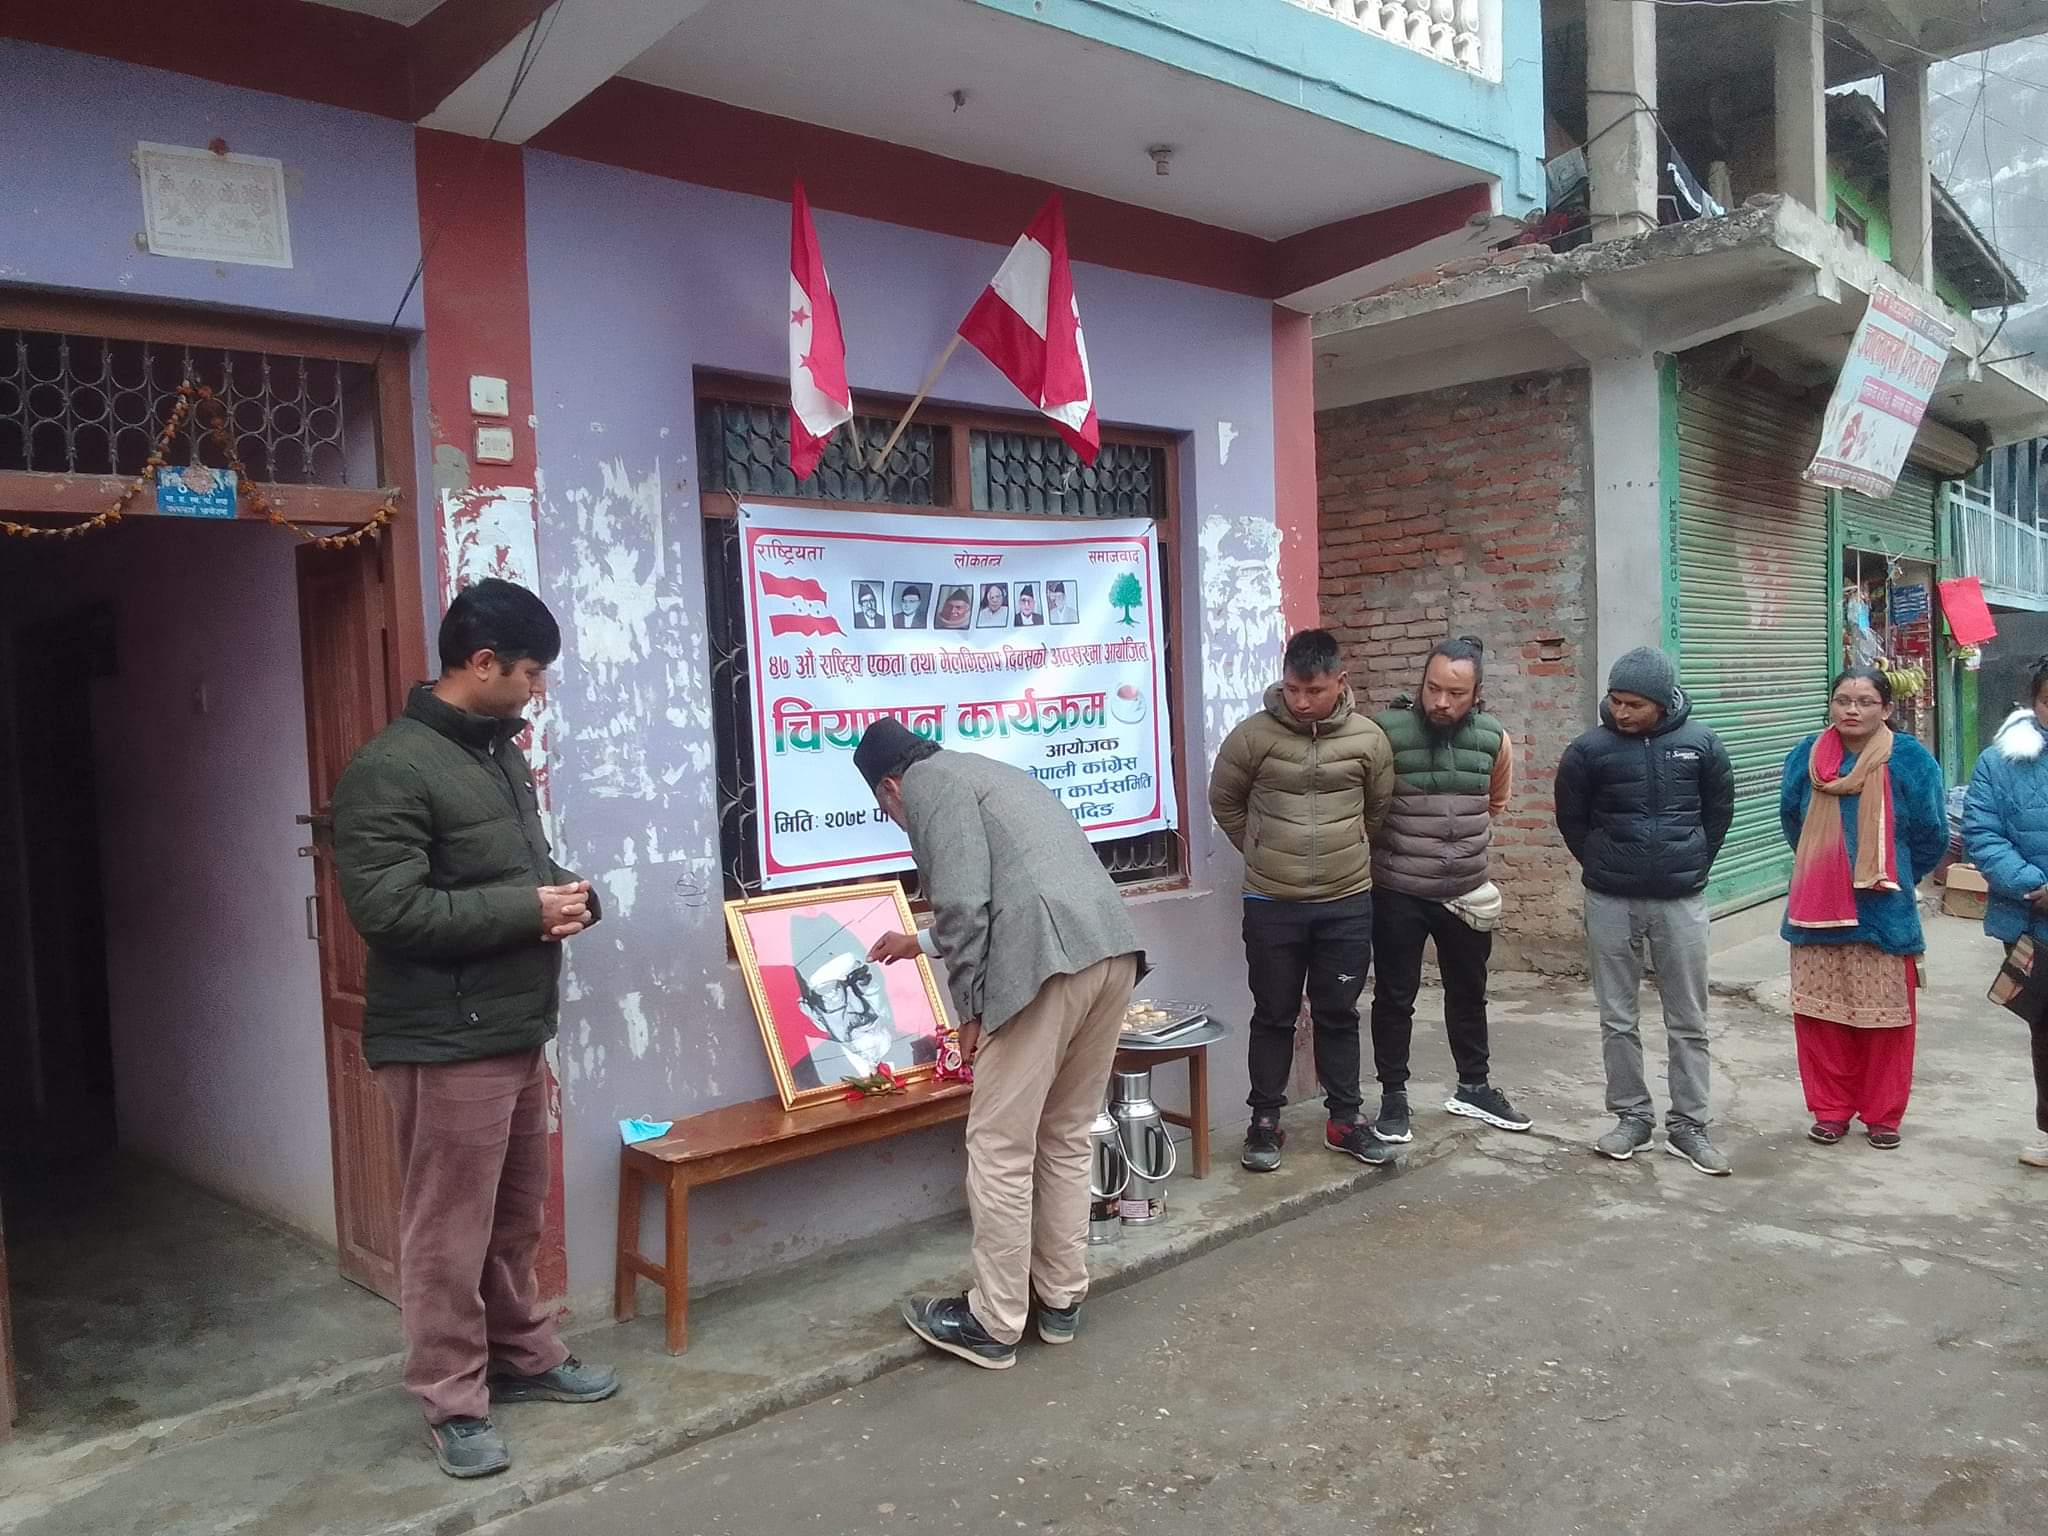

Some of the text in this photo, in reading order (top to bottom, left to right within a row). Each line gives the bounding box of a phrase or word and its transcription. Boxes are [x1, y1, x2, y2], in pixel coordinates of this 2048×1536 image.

[755, 538, 826, 565] राष्ट्रियता
[1088, 549, 1139, 565] समाजवाद
[1669, 496, 1679, 640] OPC CEMENT
[769, 655, 791, 679] ४७
[866, 653, 906, 677] एकता
[910, 652, 937, 676] तथा
[939, 646, 1002, 674] मेलमिलाप
[1002, 642, 1048, 672] दिवसको
[1050, 644, 1103, 667] अवसरमा
[1104, 636, 1149, 663] आयोजित
[957, 687, 1107, 738] कार्यक्रम
[1045, 737, 1120, 758] आयोजक
[1083, 755, 1138, 774] कांग्रेस
[1067, 772, 1152, 798] कार्यसमिति
[825, 809, 866, 828] २०७९
[1071, 801, 1115, 820] ादिङ
